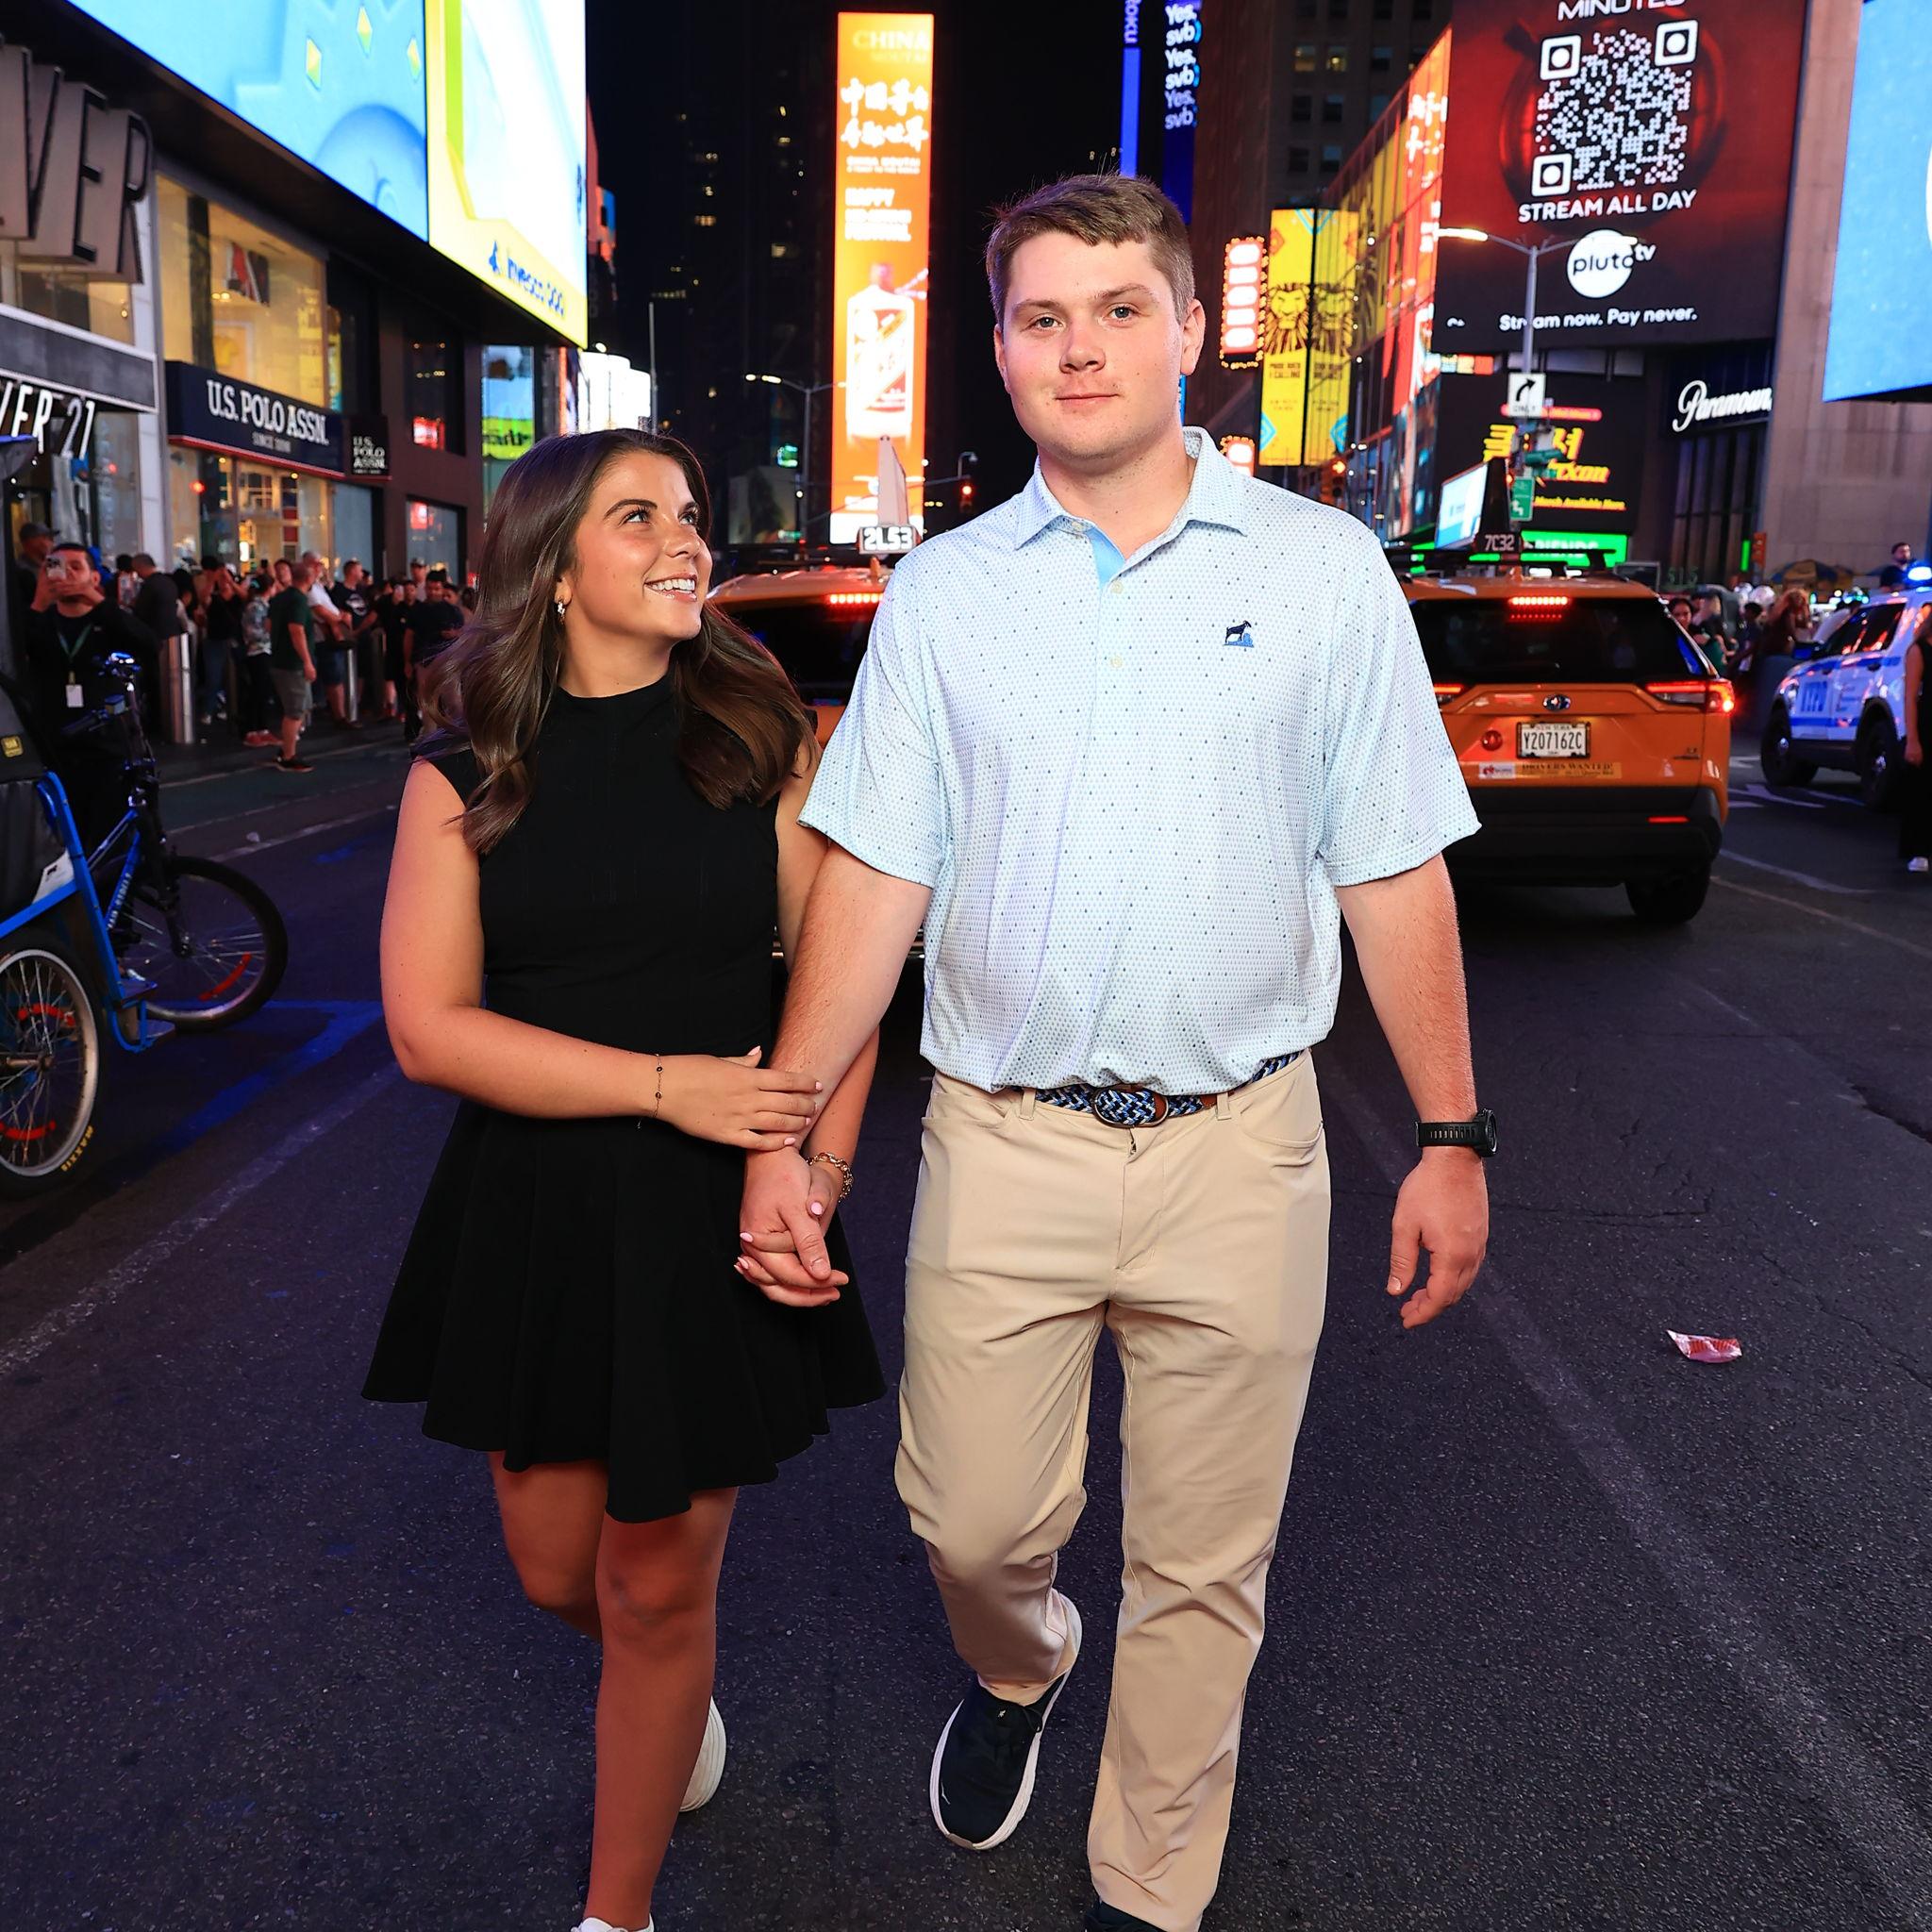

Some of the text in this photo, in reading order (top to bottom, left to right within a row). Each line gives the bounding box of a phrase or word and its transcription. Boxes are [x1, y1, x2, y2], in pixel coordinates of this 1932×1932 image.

[0, 33, 154, 285] VER
[1518, 189, 1697, 224] STREAM ALL DAY
[1573, 242, 1657, 276] pluto tv
[1499, 307, 1698, 332] Stram now. Pay never.
[206, 379, 330, 446] U.S. POLO ASSN.
[1672, 379, 1773, 432] Paramoun
[59, 395, 96, 460] 21
[353, 446, 386, 458] POLO
[1484, 534, 1515, 552] 7C32
[1523, 731, 1582, 750] Y207162C
